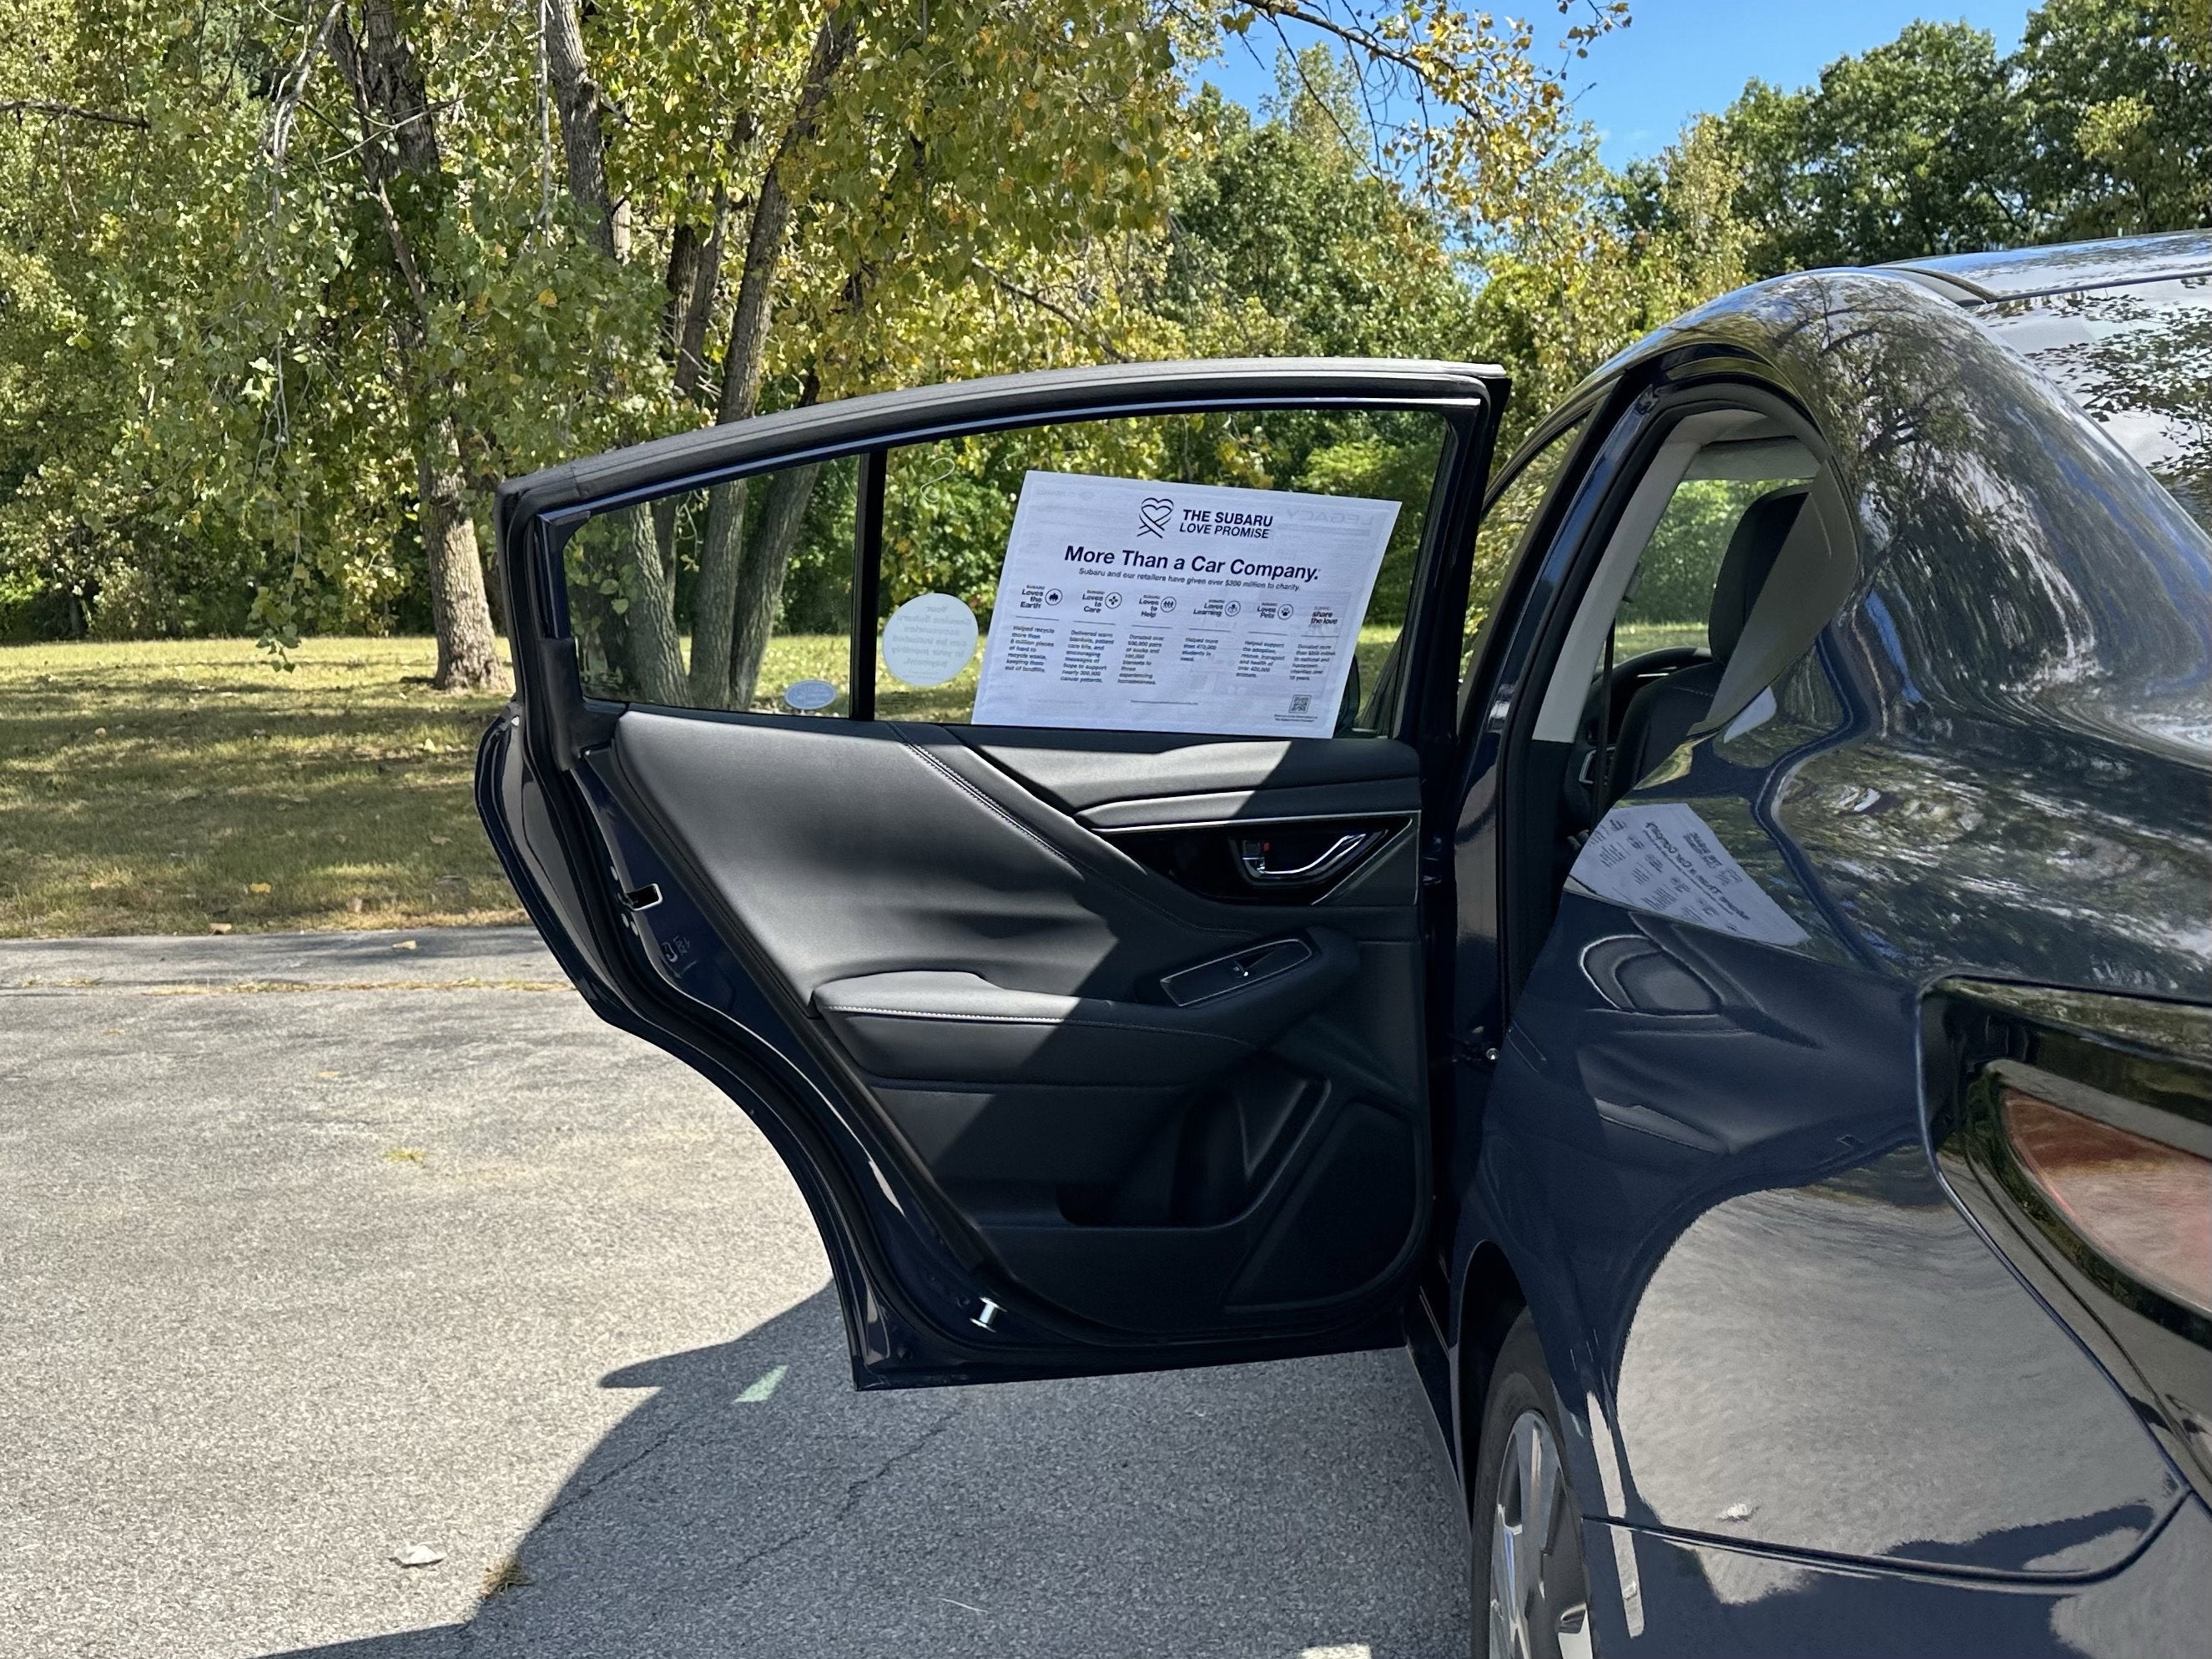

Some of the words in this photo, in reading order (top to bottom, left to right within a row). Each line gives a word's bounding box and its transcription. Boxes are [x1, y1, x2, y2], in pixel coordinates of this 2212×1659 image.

[1183, 509, 1212, 522] THE
[1214, 512, 1273, 527] SUBARU
[1179, 522, 1212, 534] LOVE
[1214, 525, 1270, 538] PROMISE
[1065, 545, 1115, 564] More
[1122, 549, 1168, 569] Than
[1173, 557, 1185, 570] a
[1192, 556, 1226, 572] Car
[1230, 558, 1318, 582] Company.
[1078, 567, 1106, 577] Subaru
[1136, 573, 1166, 582] retailers
[1167, 575, 1185, 583] have
[1187, 576, 1206, 585] given
[1242, 580, 1266, 588] million
[1021, 588, 1044, 597] Loves
[1192, 608, 1222, 618] Learning
